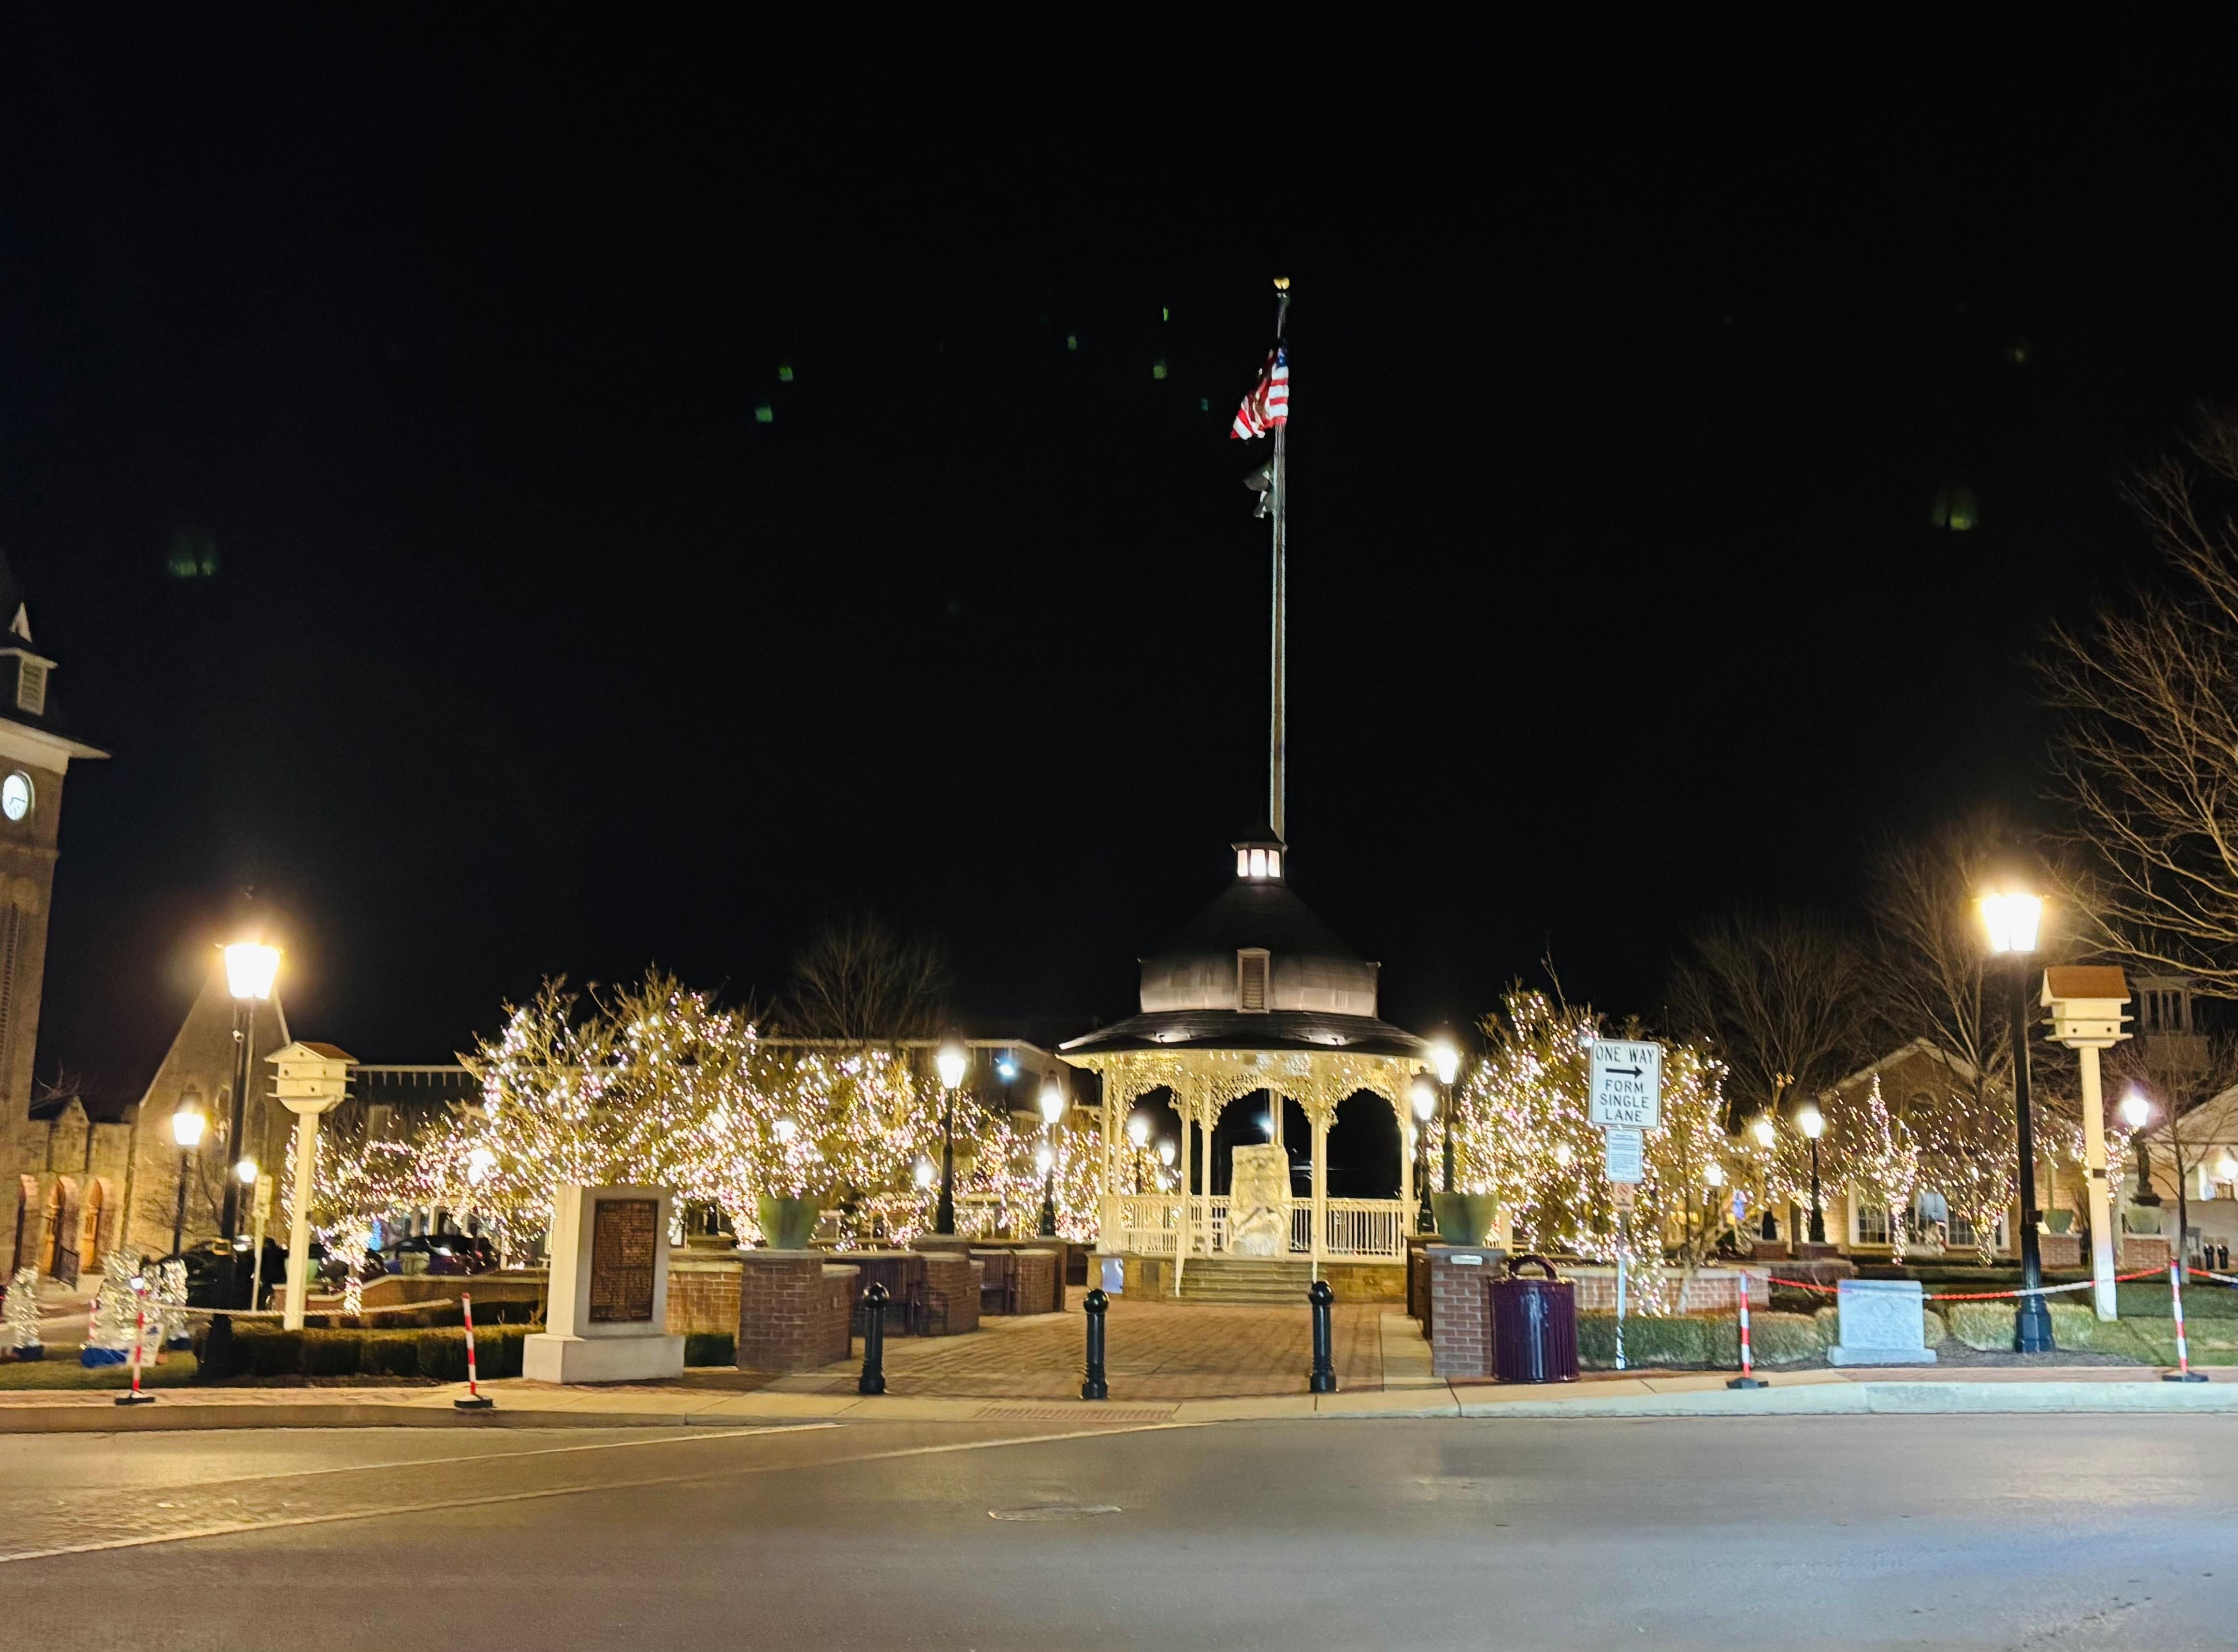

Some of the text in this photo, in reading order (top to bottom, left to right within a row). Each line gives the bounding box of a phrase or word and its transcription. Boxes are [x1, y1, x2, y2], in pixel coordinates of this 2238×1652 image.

[1596, 1044, 1654, 1064] ONE WAY
[1605, 1079, 1643, 1094] FORM
[1600, 1093, 1649, 1109] SINGLE
[1605, 1108, 1642, 1122] LANE
